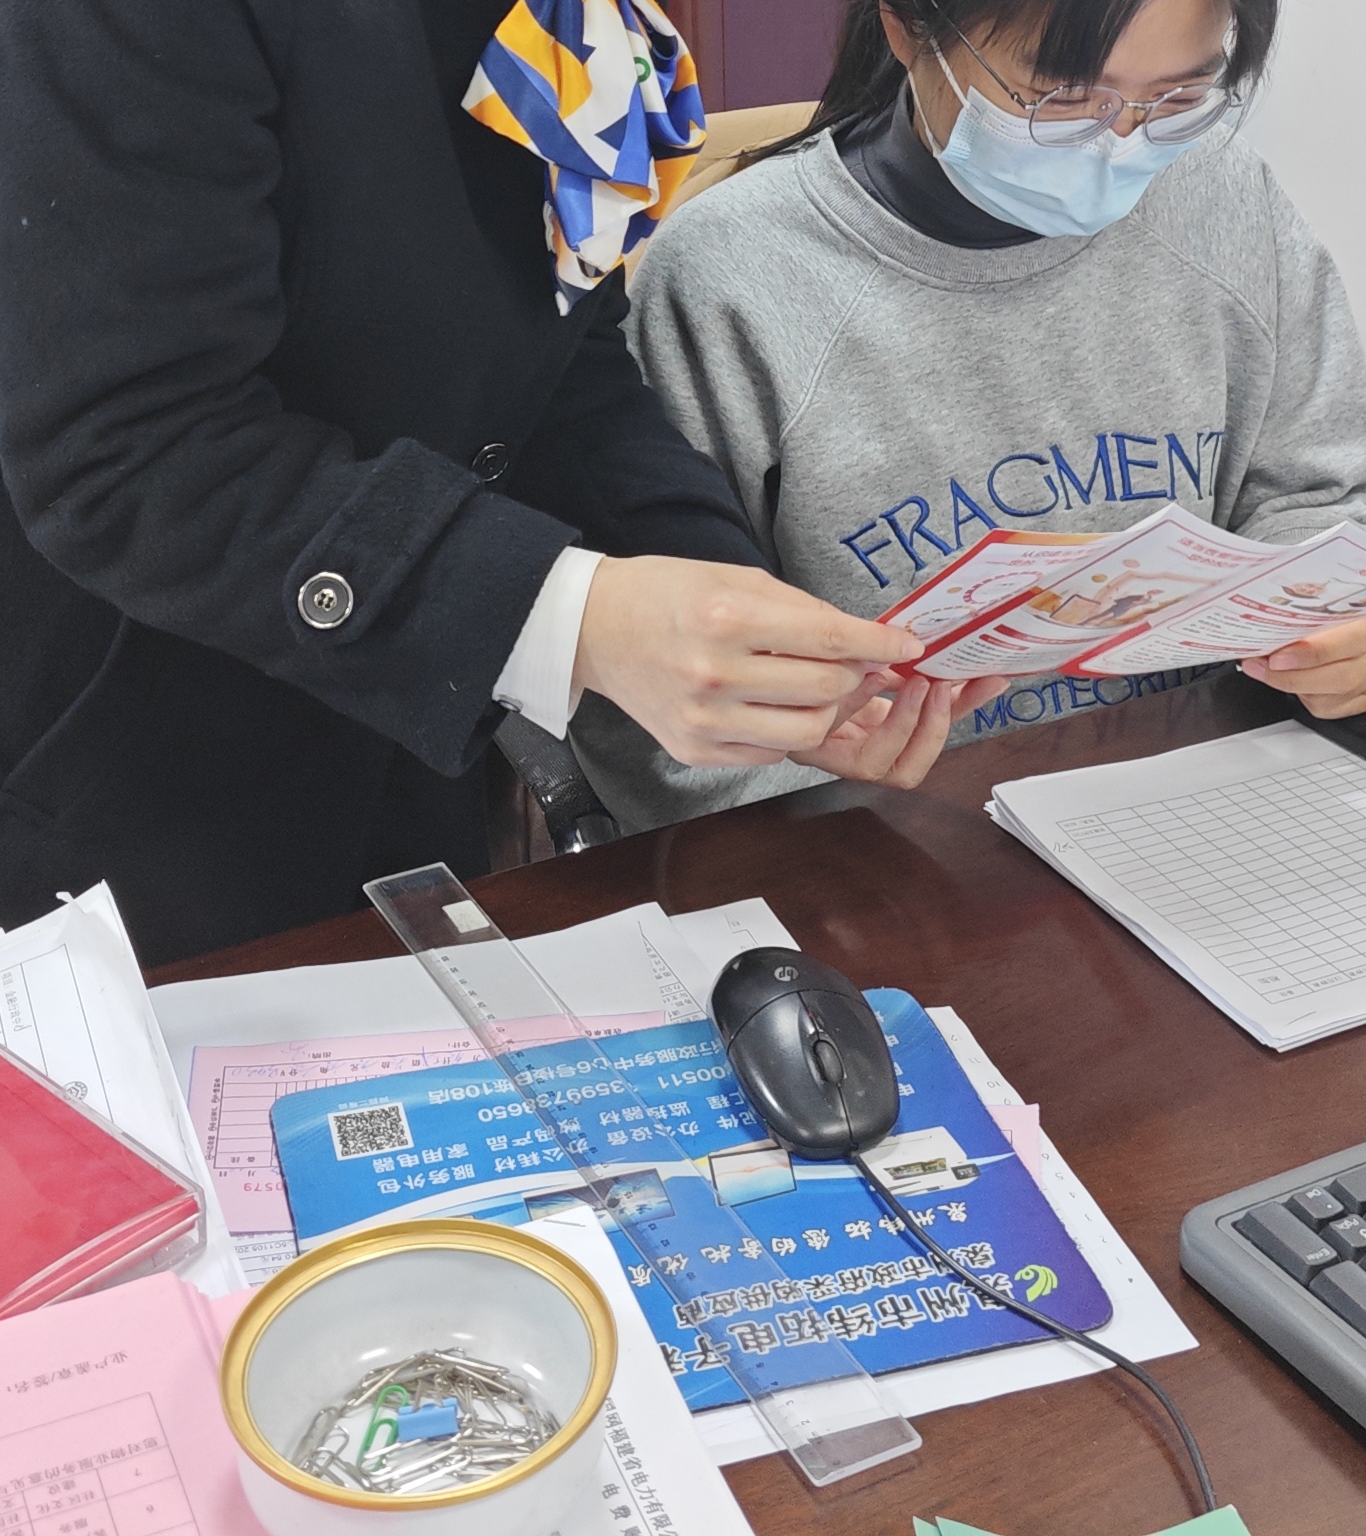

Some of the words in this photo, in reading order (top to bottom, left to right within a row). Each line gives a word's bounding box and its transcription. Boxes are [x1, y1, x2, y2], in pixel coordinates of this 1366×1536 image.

[840, 431, 1227, 588] FRAGMENT
[774, 965, 799, 982] hp
[658, 1062, 733, 1090] 00511
[477, 1078, 641, 1124] 3599738650
[599, 1100, 691, 1126] 监控器材
[486, 1116, 581, 1152] 数码产品
[607, 1120, 701, 1148] 办公设备
[373, 1142, 470, 1174] 家用电器
[494, 1137, 589, 1174] 办公耗材
[378, 1162, 476, 1196] 服务外包
[673, 1242, 996, 1330] 泉州市政府采购供应商
